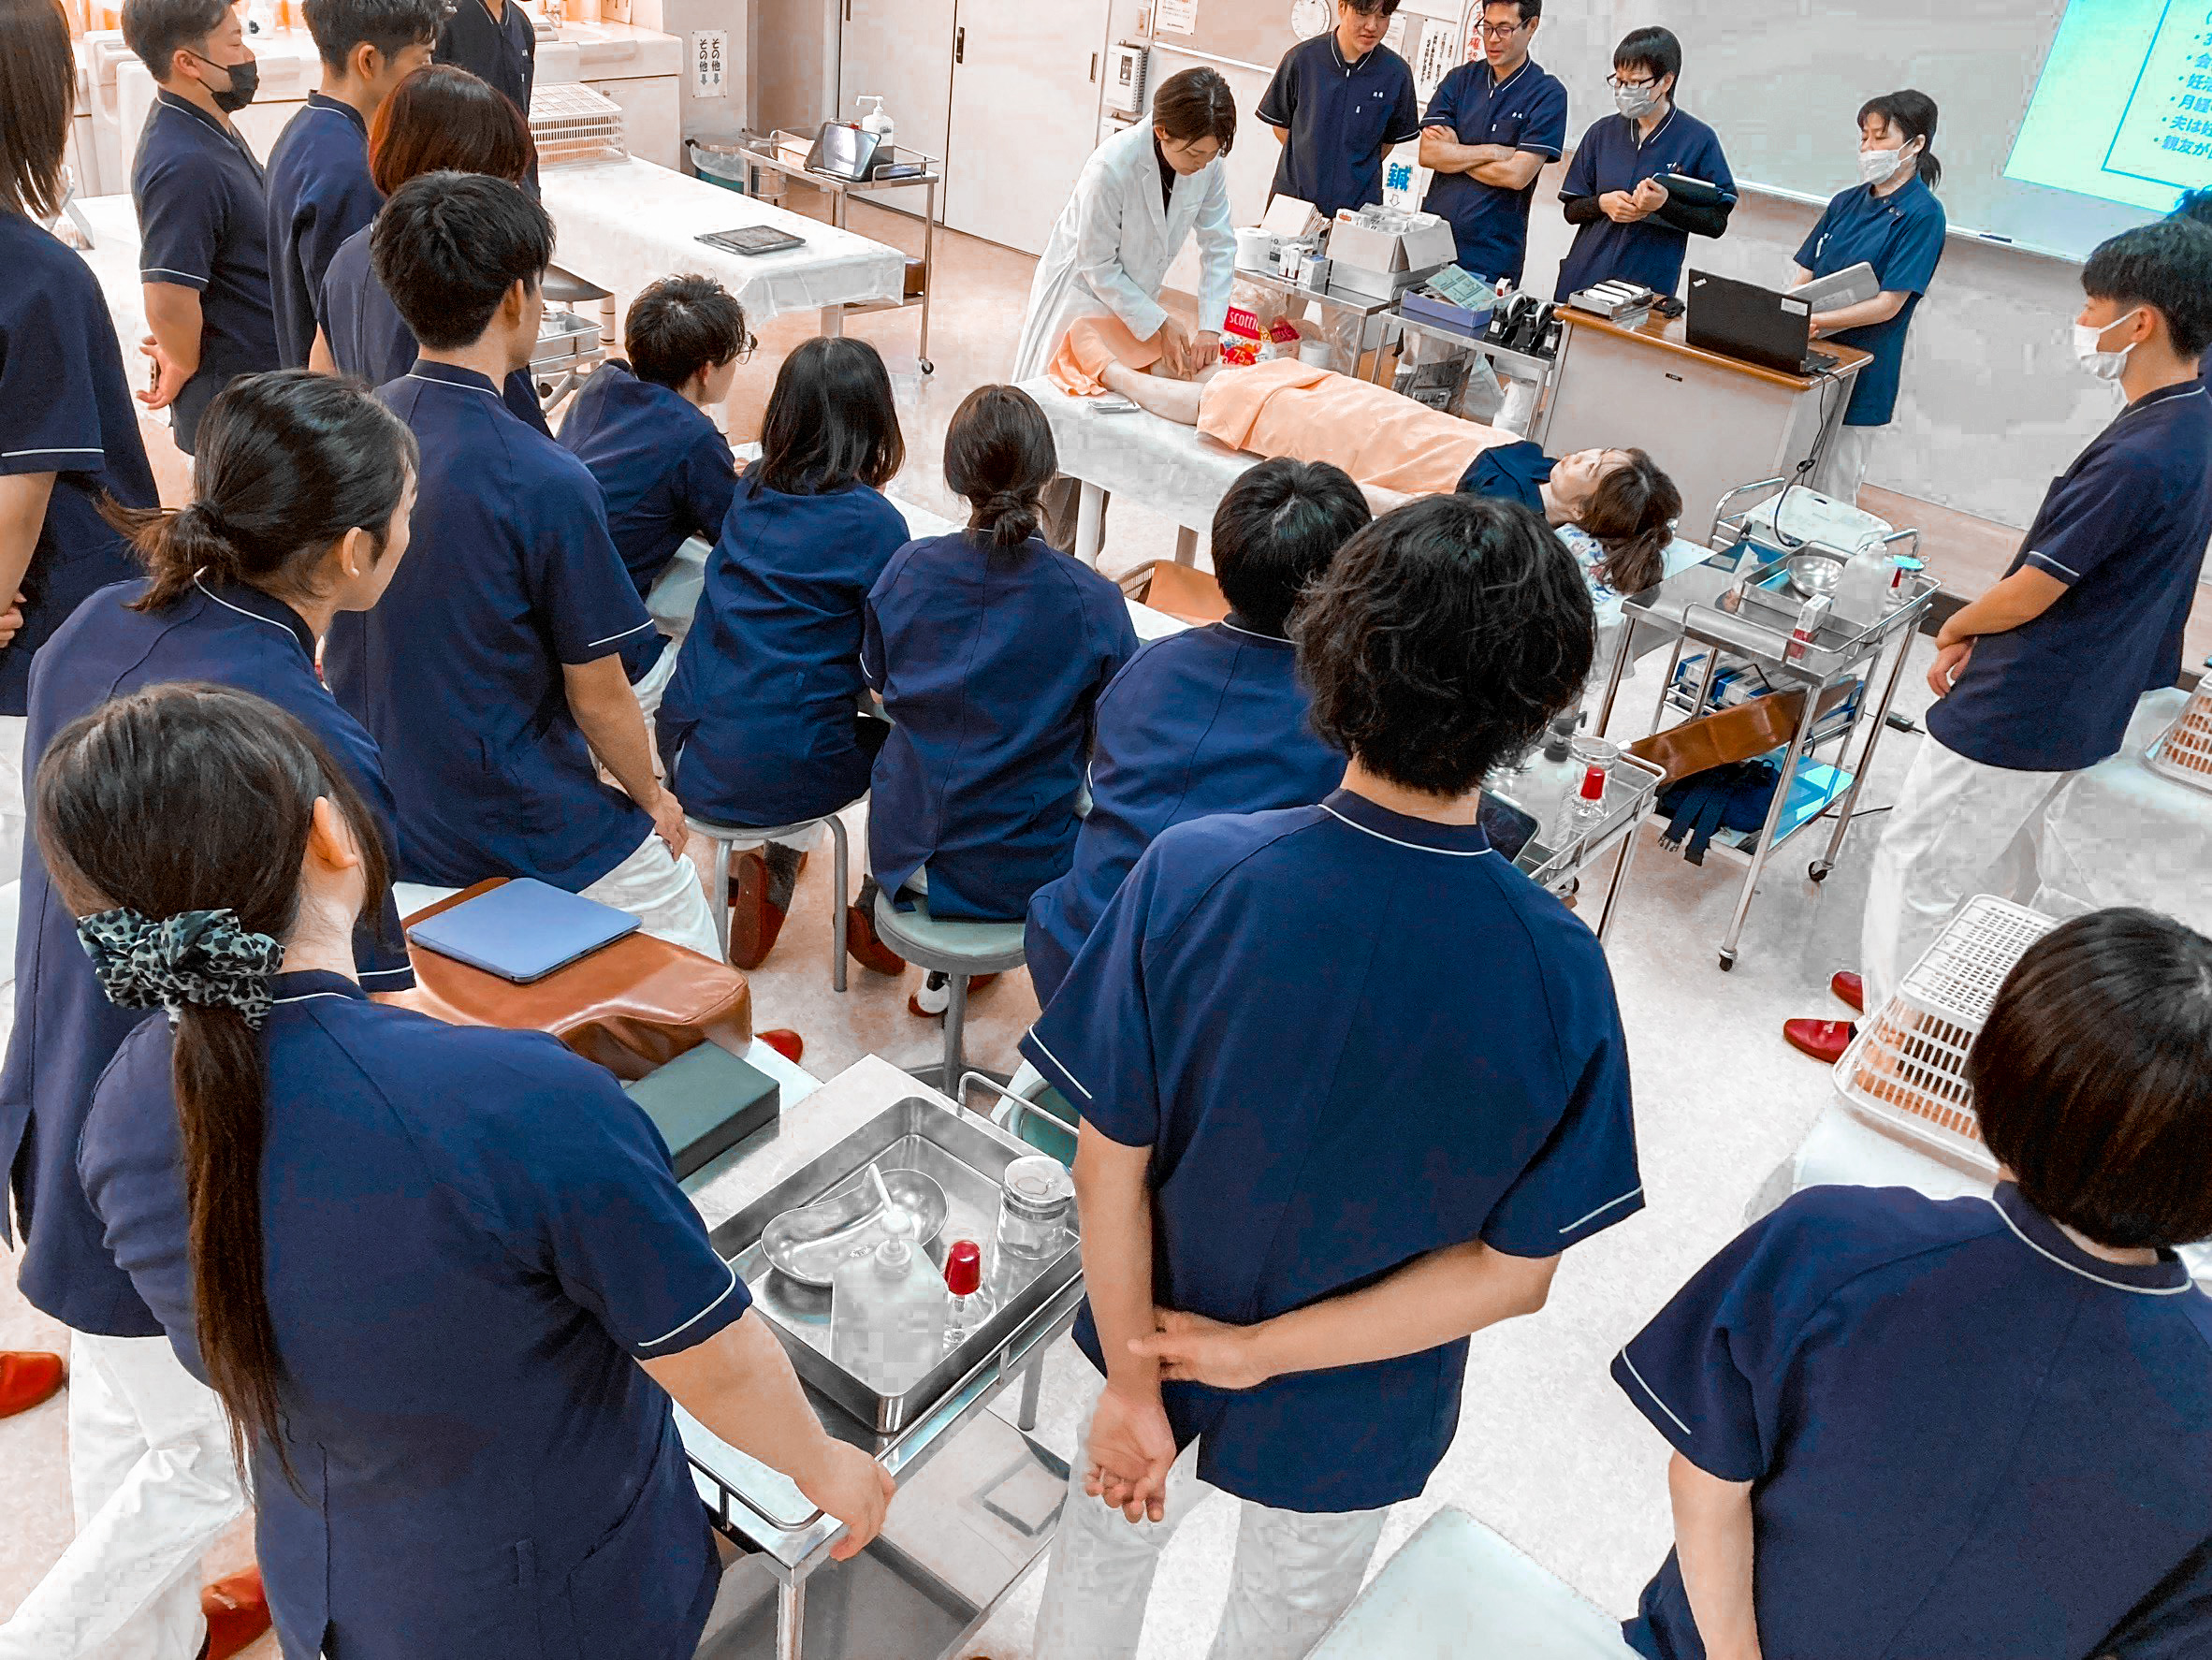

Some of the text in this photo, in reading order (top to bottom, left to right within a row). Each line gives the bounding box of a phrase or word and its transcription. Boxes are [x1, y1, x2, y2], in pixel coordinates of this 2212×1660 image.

[699, 38, 708, 72] その他
[711, 38, 720, 71] その他
[2194, 52, 2212, 70] 会
[2177, 94, 2212, 113] 月経
